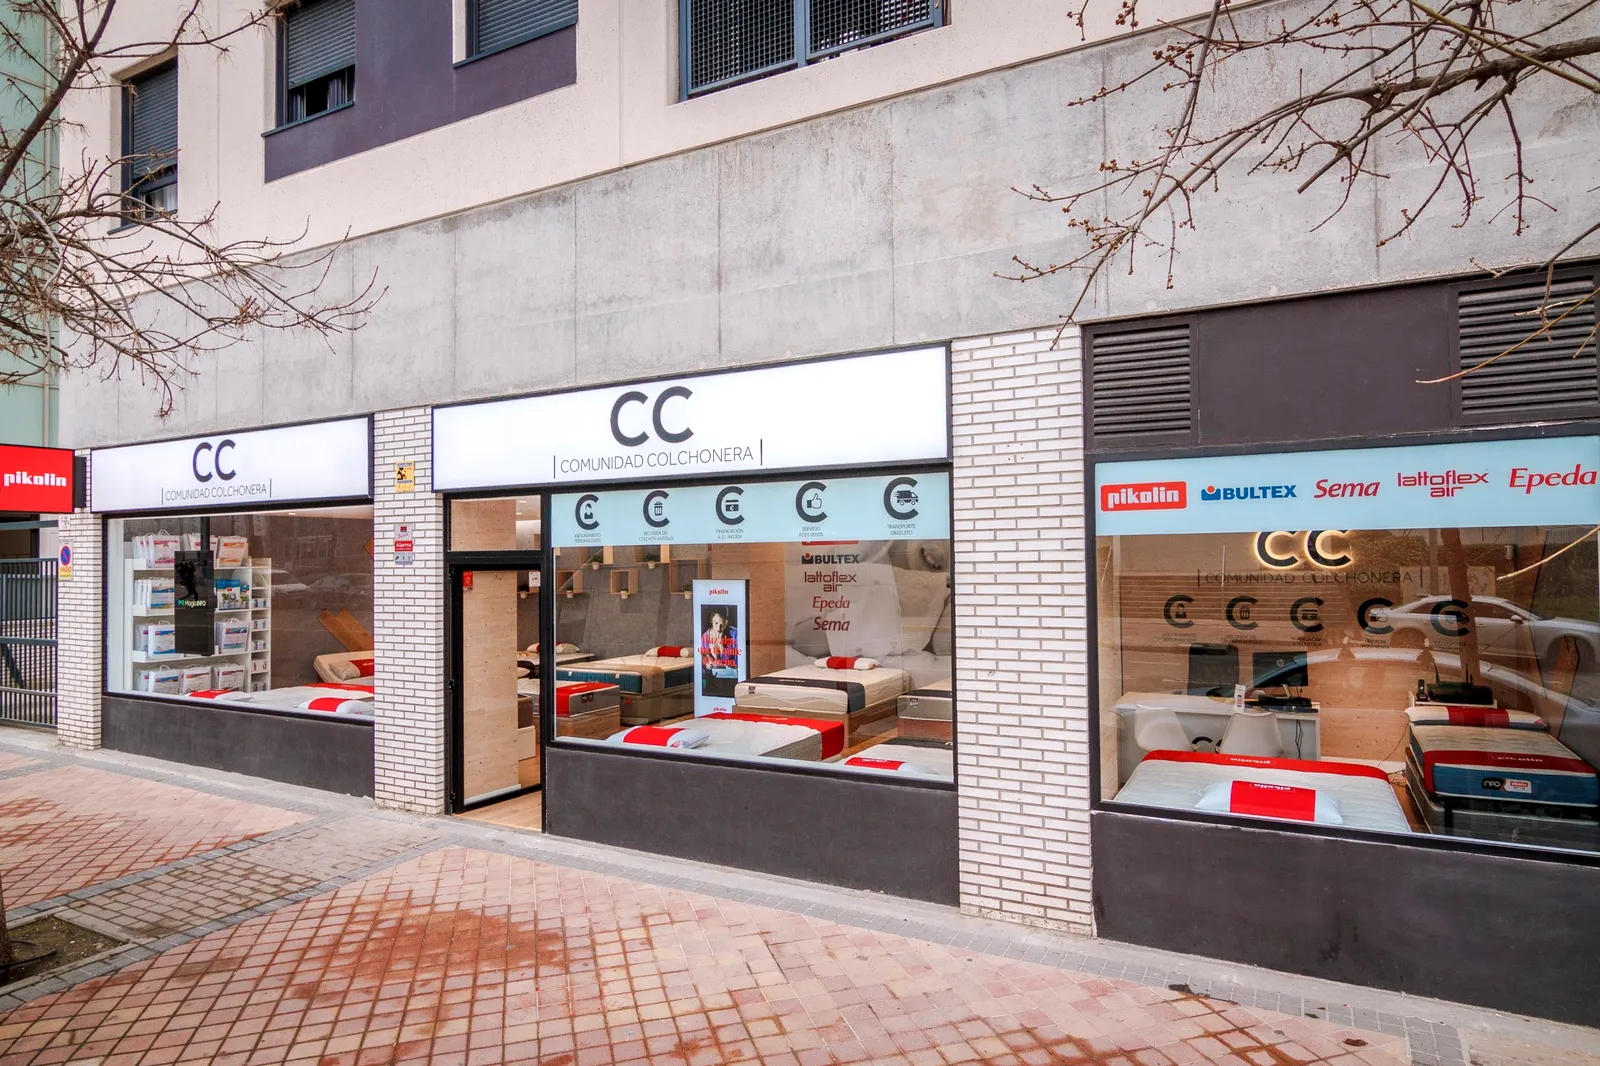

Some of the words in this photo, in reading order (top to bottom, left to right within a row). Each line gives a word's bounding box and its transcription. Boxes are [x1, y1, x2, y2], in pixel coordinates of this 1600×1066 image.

[610, 386, 694, 447] CC
[193, 439, 236, 482] CC
[560, 455, 644, 473] COMUNIDAD
[647, 447, 754, 467] COLCHONERA
[4, 471, 67, 487] pikolin
[1397, 470, 1489, 487] lattoflex
[1509, 464, 1598, 494] Epeda
[165, 488, 210, 501] COMUNIDAD
[211, 484, 267, 498] COLCHONERA
[1107, 486, 1179, 508] pikolin
[1223, 485, 1297, 500] BULTEX
[1314, 479, 1380, 499] Sema
[1430, 486, 1464, 497] air
[1256, 531, 1353, 569] CC
[814, 554, 859, 564] BULTEX
[804, 571, 857, 583] lattoflex
[1205, 572, 1294, 584] COMUNIDAD
[1302, 571, 1413, 584] COLCHONERA
[823, 584, 842, 592] air
[812, 596, 850, 612] Epeda
[813, 616, 850, 631] Sema
